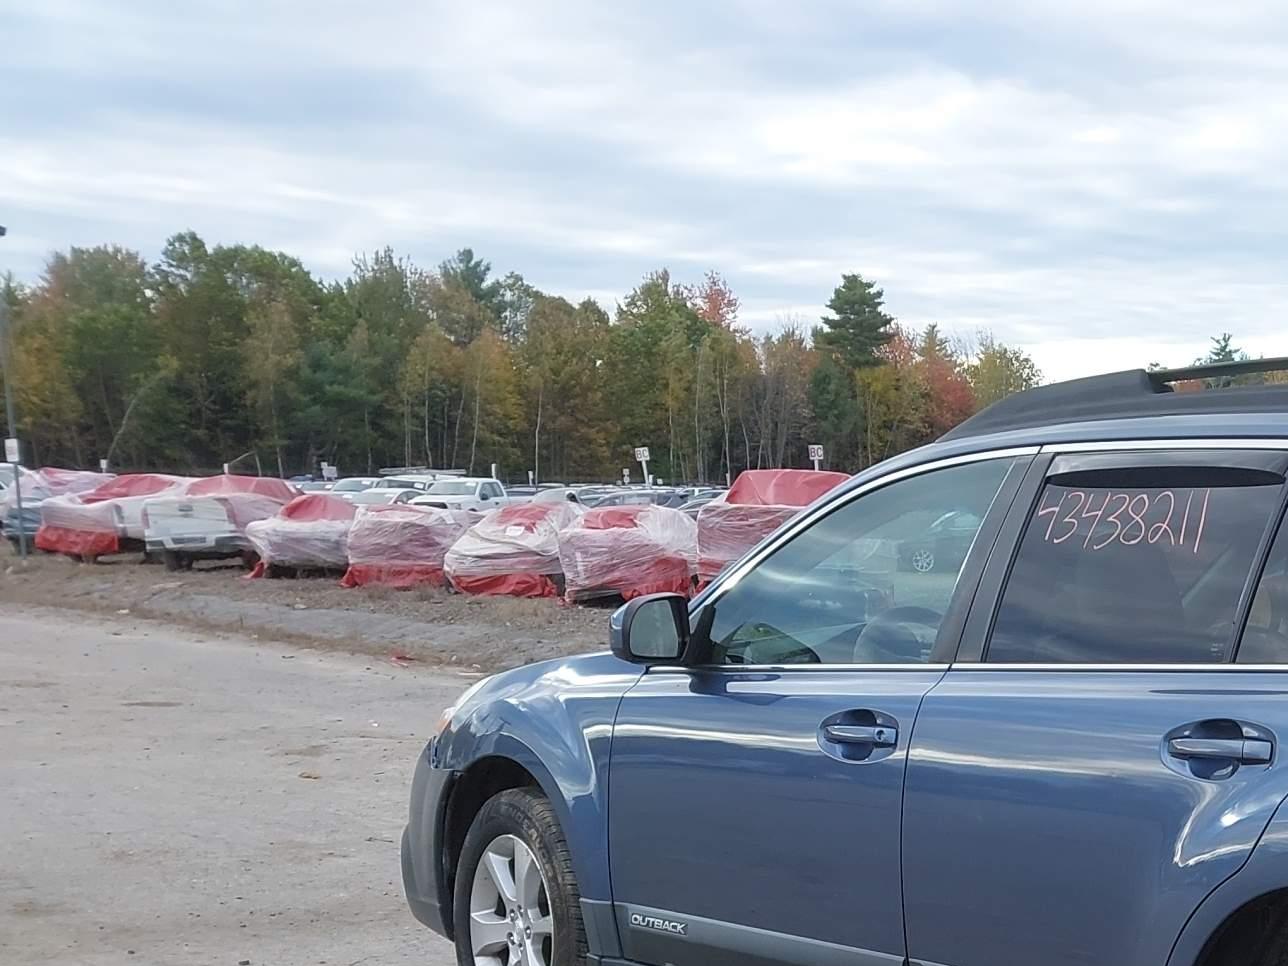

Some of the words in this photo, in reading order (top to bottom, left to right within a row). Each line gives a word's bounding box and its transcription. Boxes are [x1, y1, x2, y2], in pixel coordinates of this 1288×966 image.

[809, 447, 823, 458] BC
[1037, 488, 1210, 554] 43438211
[631, 913, 686, 935] OUTBACK
